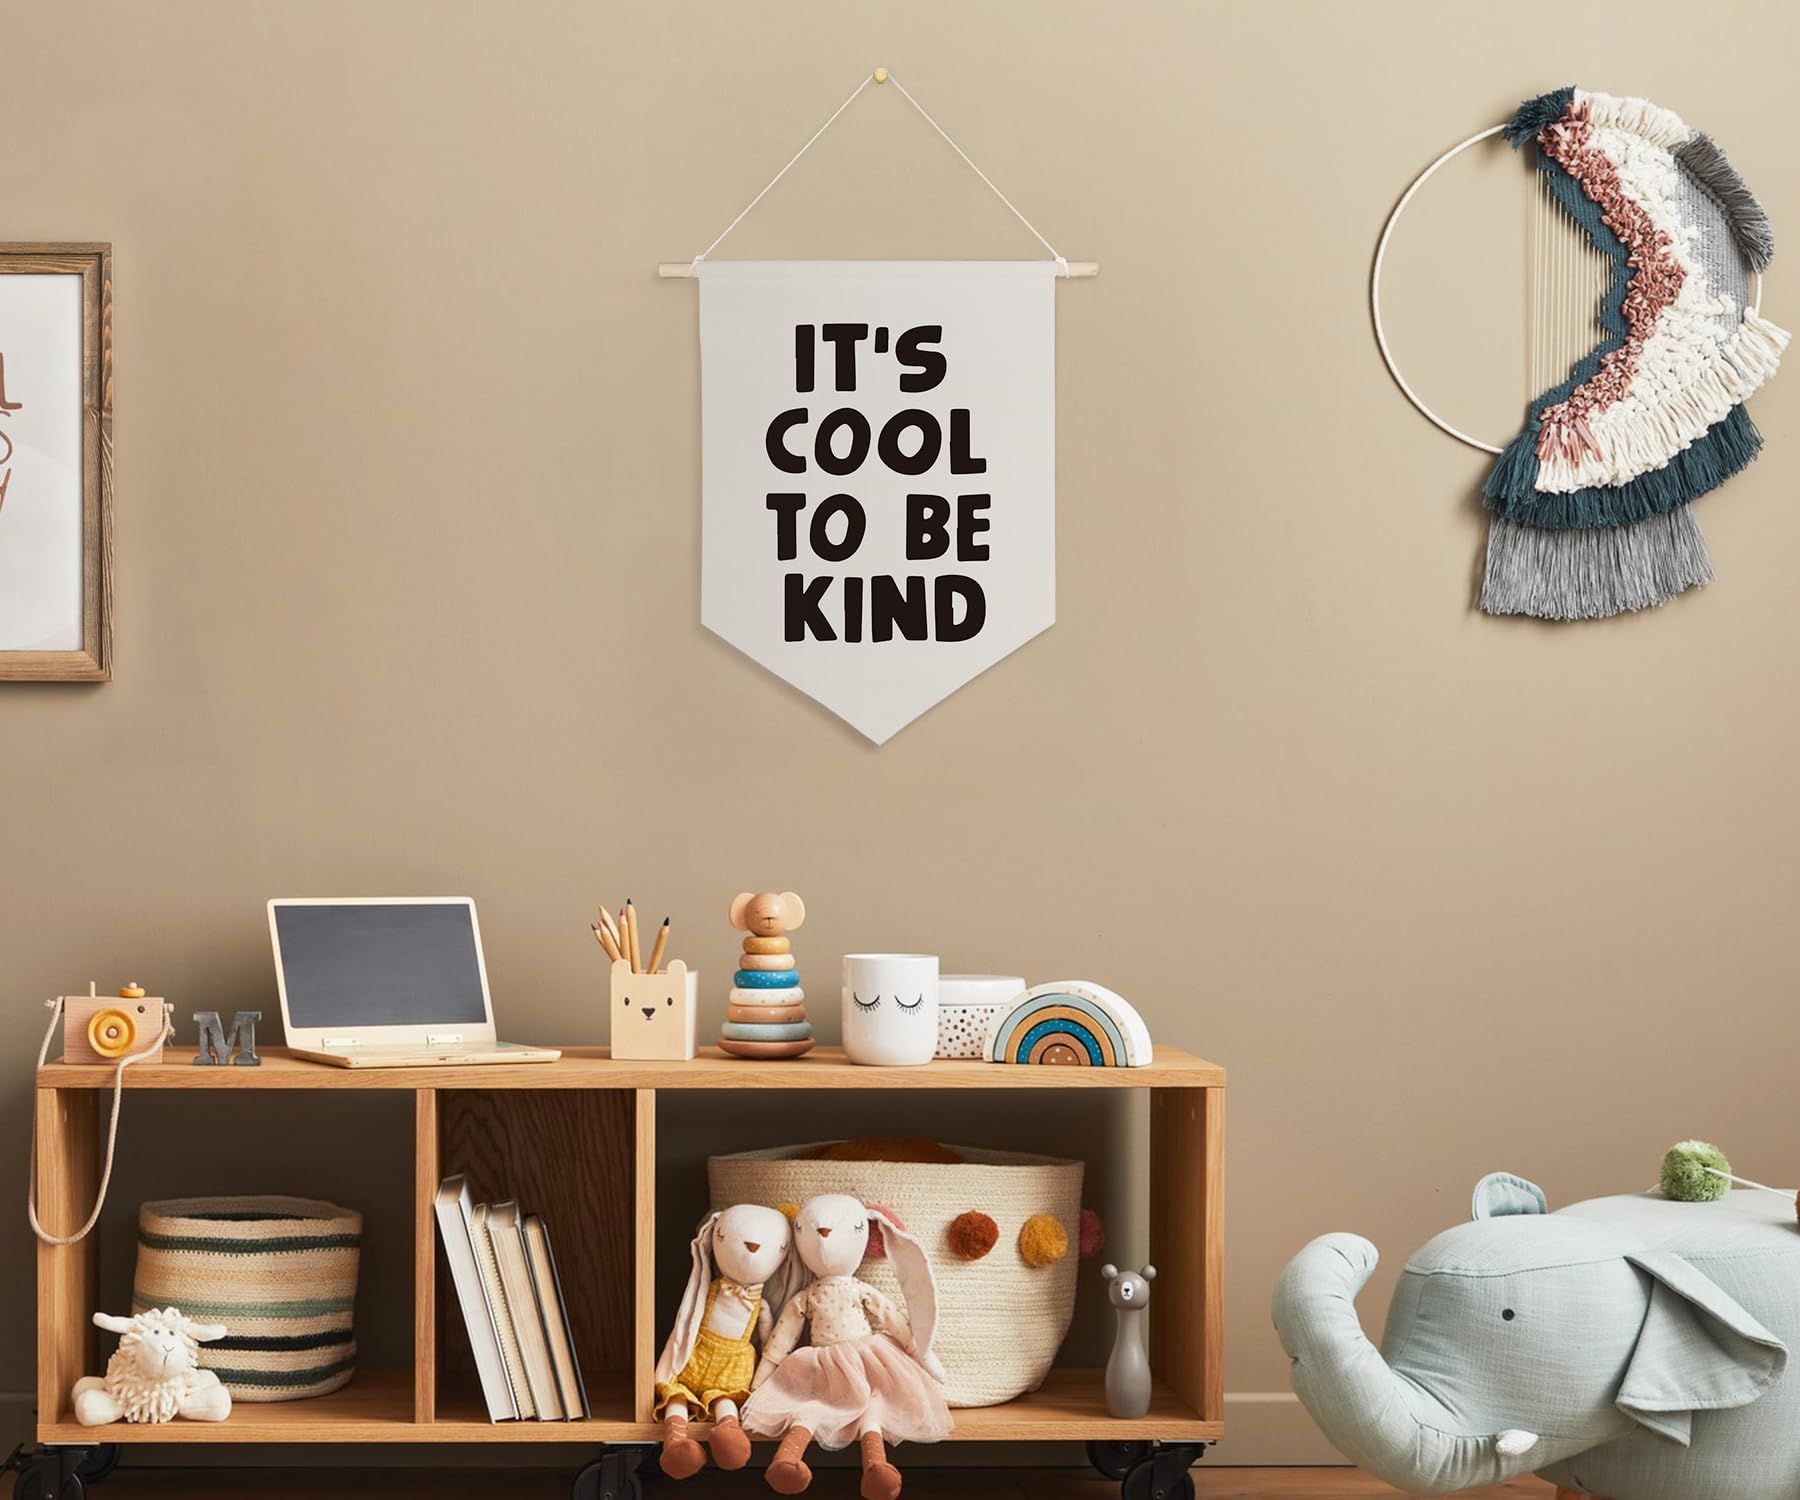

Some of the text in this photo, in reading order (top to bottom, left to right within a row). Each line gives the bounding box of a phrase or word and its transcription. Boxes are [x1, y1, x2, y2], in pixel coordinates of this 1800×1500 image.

[796, 324, 946, 393] IT'S
[766, 408, 986, 475] COOL
[766, 493, 991, 562] TO BE
[785, 574, 987, 643] KIND
[193, 1011, 262, 1066] M
